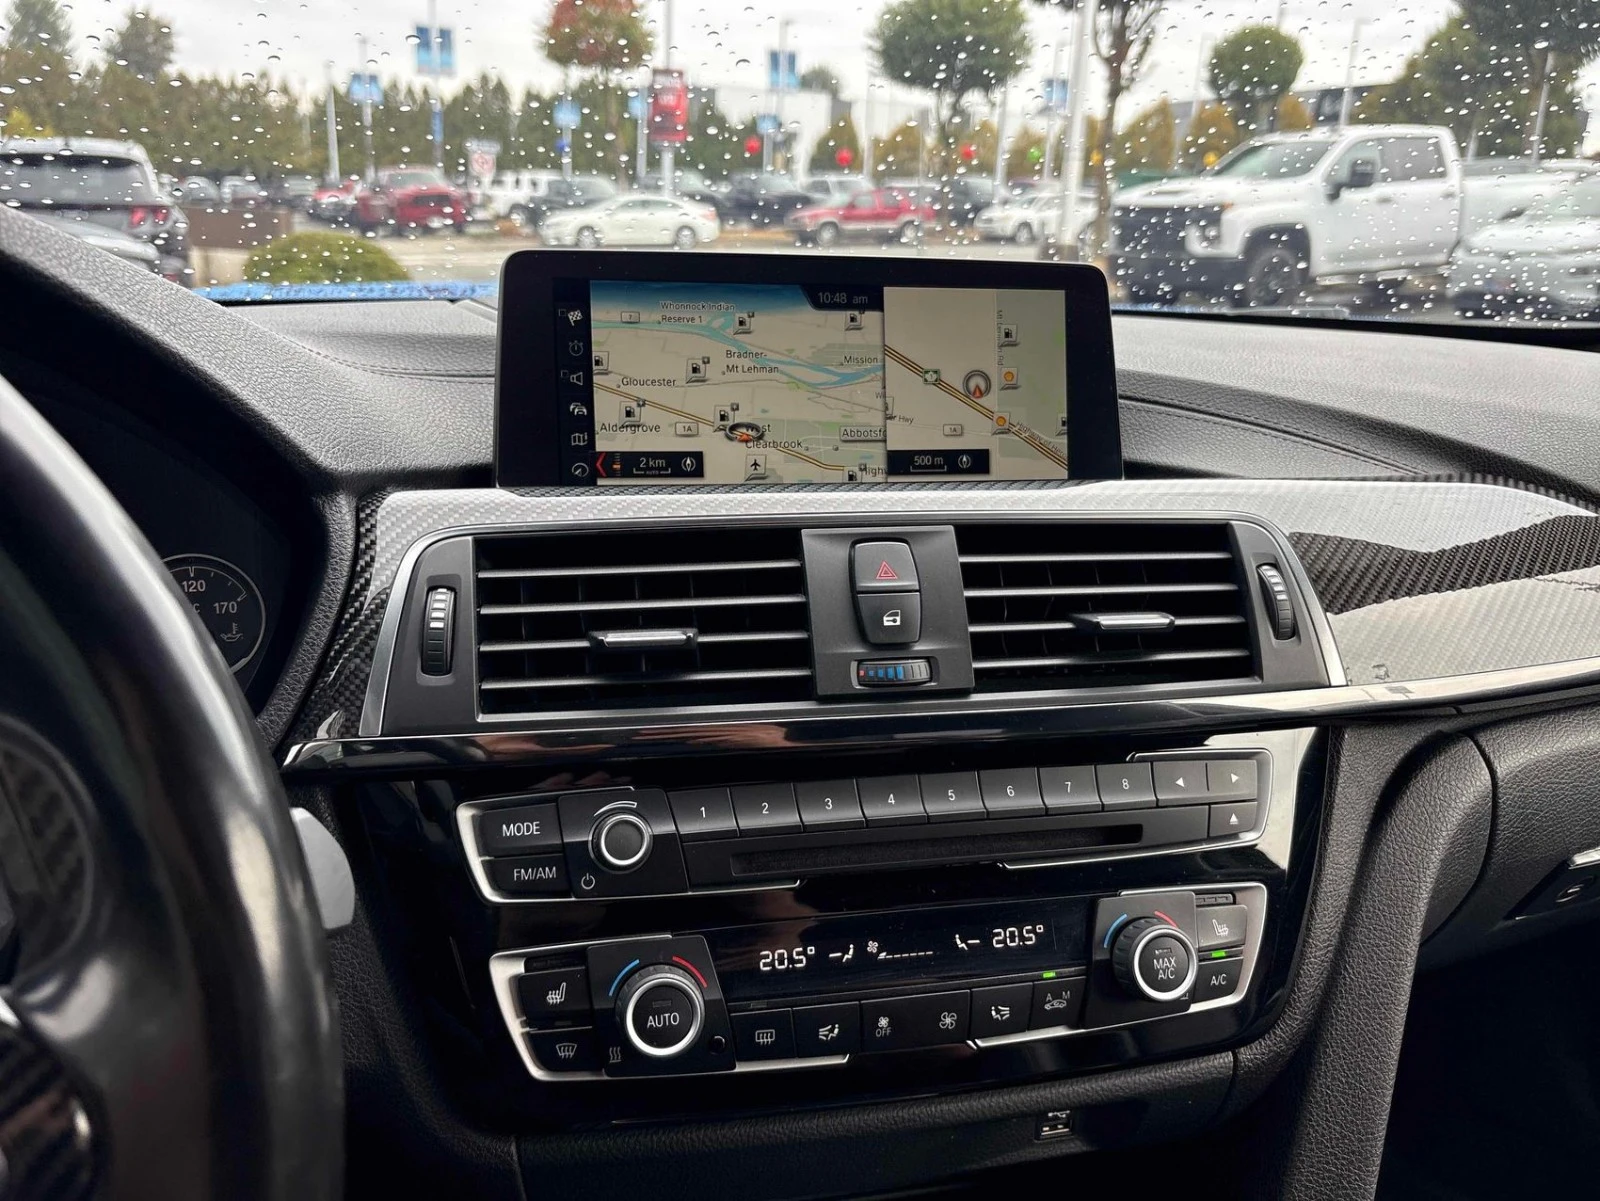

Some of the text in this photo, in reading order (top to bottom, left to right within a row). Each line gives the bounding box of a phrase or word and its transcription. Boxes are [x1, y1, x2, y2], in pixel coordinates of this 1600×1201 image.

[818, 292, 868, 304] 10:48 am
[660, 301, 736, 311] Whonnock Indian
[661, 314, 703, 324] Reserve 1
[726, 350, 768, 359] Bradner-
[844, 355, 878, 364] Mission
[726, 364, 779, 374] Mt Lehman
[621, 377, 677, 388] Gloucester
[898, 414, 914, 425] Hwy
[600, 422, 661, 434] Aldergrove
[682, 425, 692, 433] 1A
[745, 439, 803, 449] Clearbrook
[639, 457, 666, 467] 2 km
[914, 455, 944, 466] 500 m
[182, 579, 206, 593] 120
[213, 601, 238, 614] 170
[1065, 781, 1072, 793] 7
[1121, 778, 1130, 790] 8
[948, 789, 956, 801] 5
[1006, 785, 1015, 797] 6
[824, 798, 833, 810] 3
[887, 793, 896, 805] 4
[700, 806, 706, 819] 1
[762, 802, 769, 814] 2
[502, 821, 541, 837] MODE
[513, 866, 557, 881] FM/AM
[1153, 956, 1177, 970] MAX
[1157, 968, 1176, 980] A/C
[1210, 973, 1227, 986] A/C
[1045, 990, 1071, 1001] A M
[646, 1011, 680, 1029] AUTO
[875, 1027, 892, 1038] OFF
